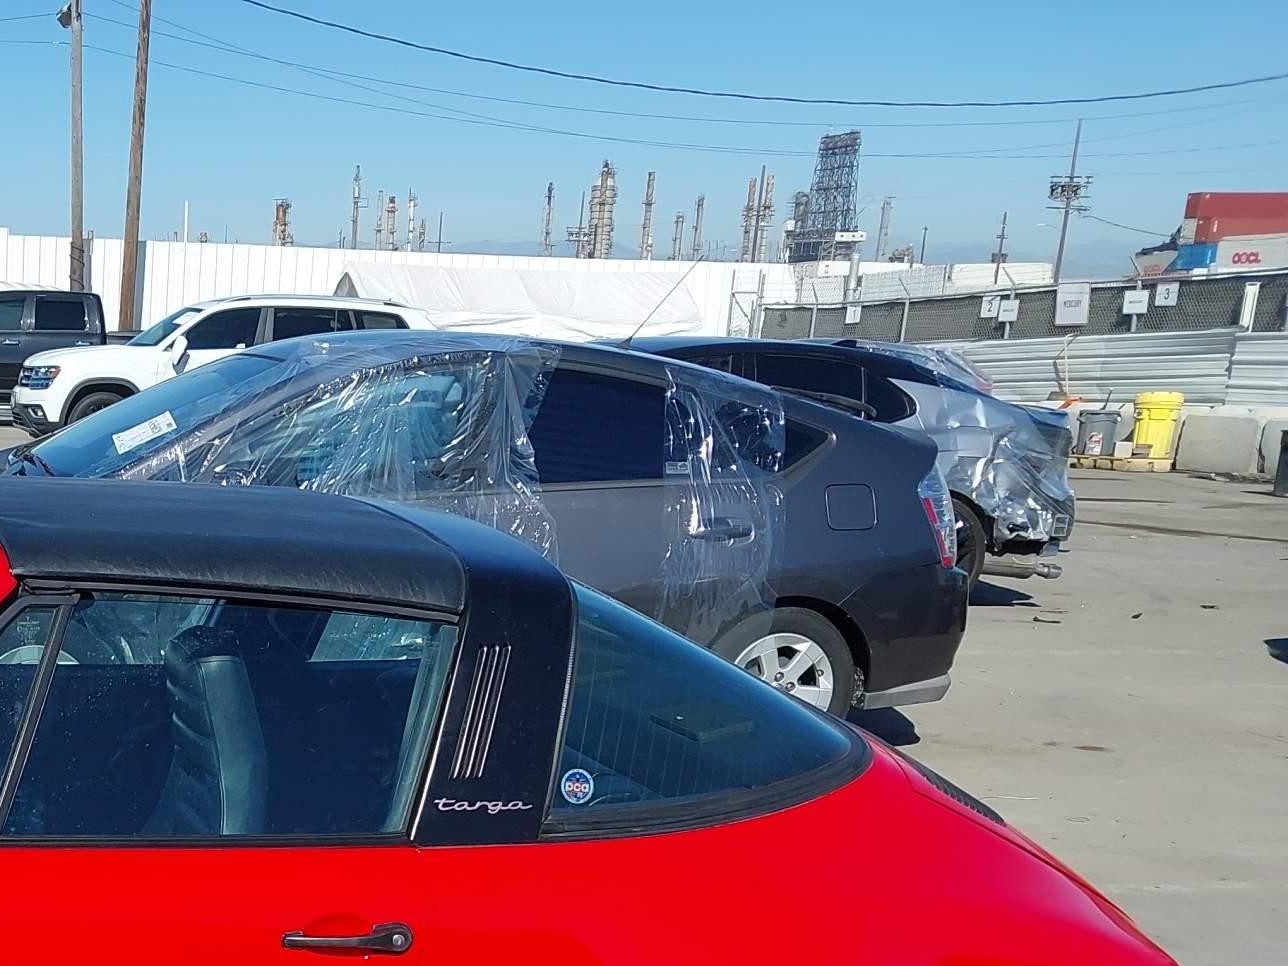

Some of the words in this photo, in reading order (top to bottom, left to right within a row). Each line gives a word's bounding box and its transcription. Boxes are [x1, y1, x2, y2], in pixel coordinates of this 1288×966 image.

[1232, 252, 1261, 264] OOCL
[1163, 287, 1170, 300] 3
[433, 797, 533, 815] targa
